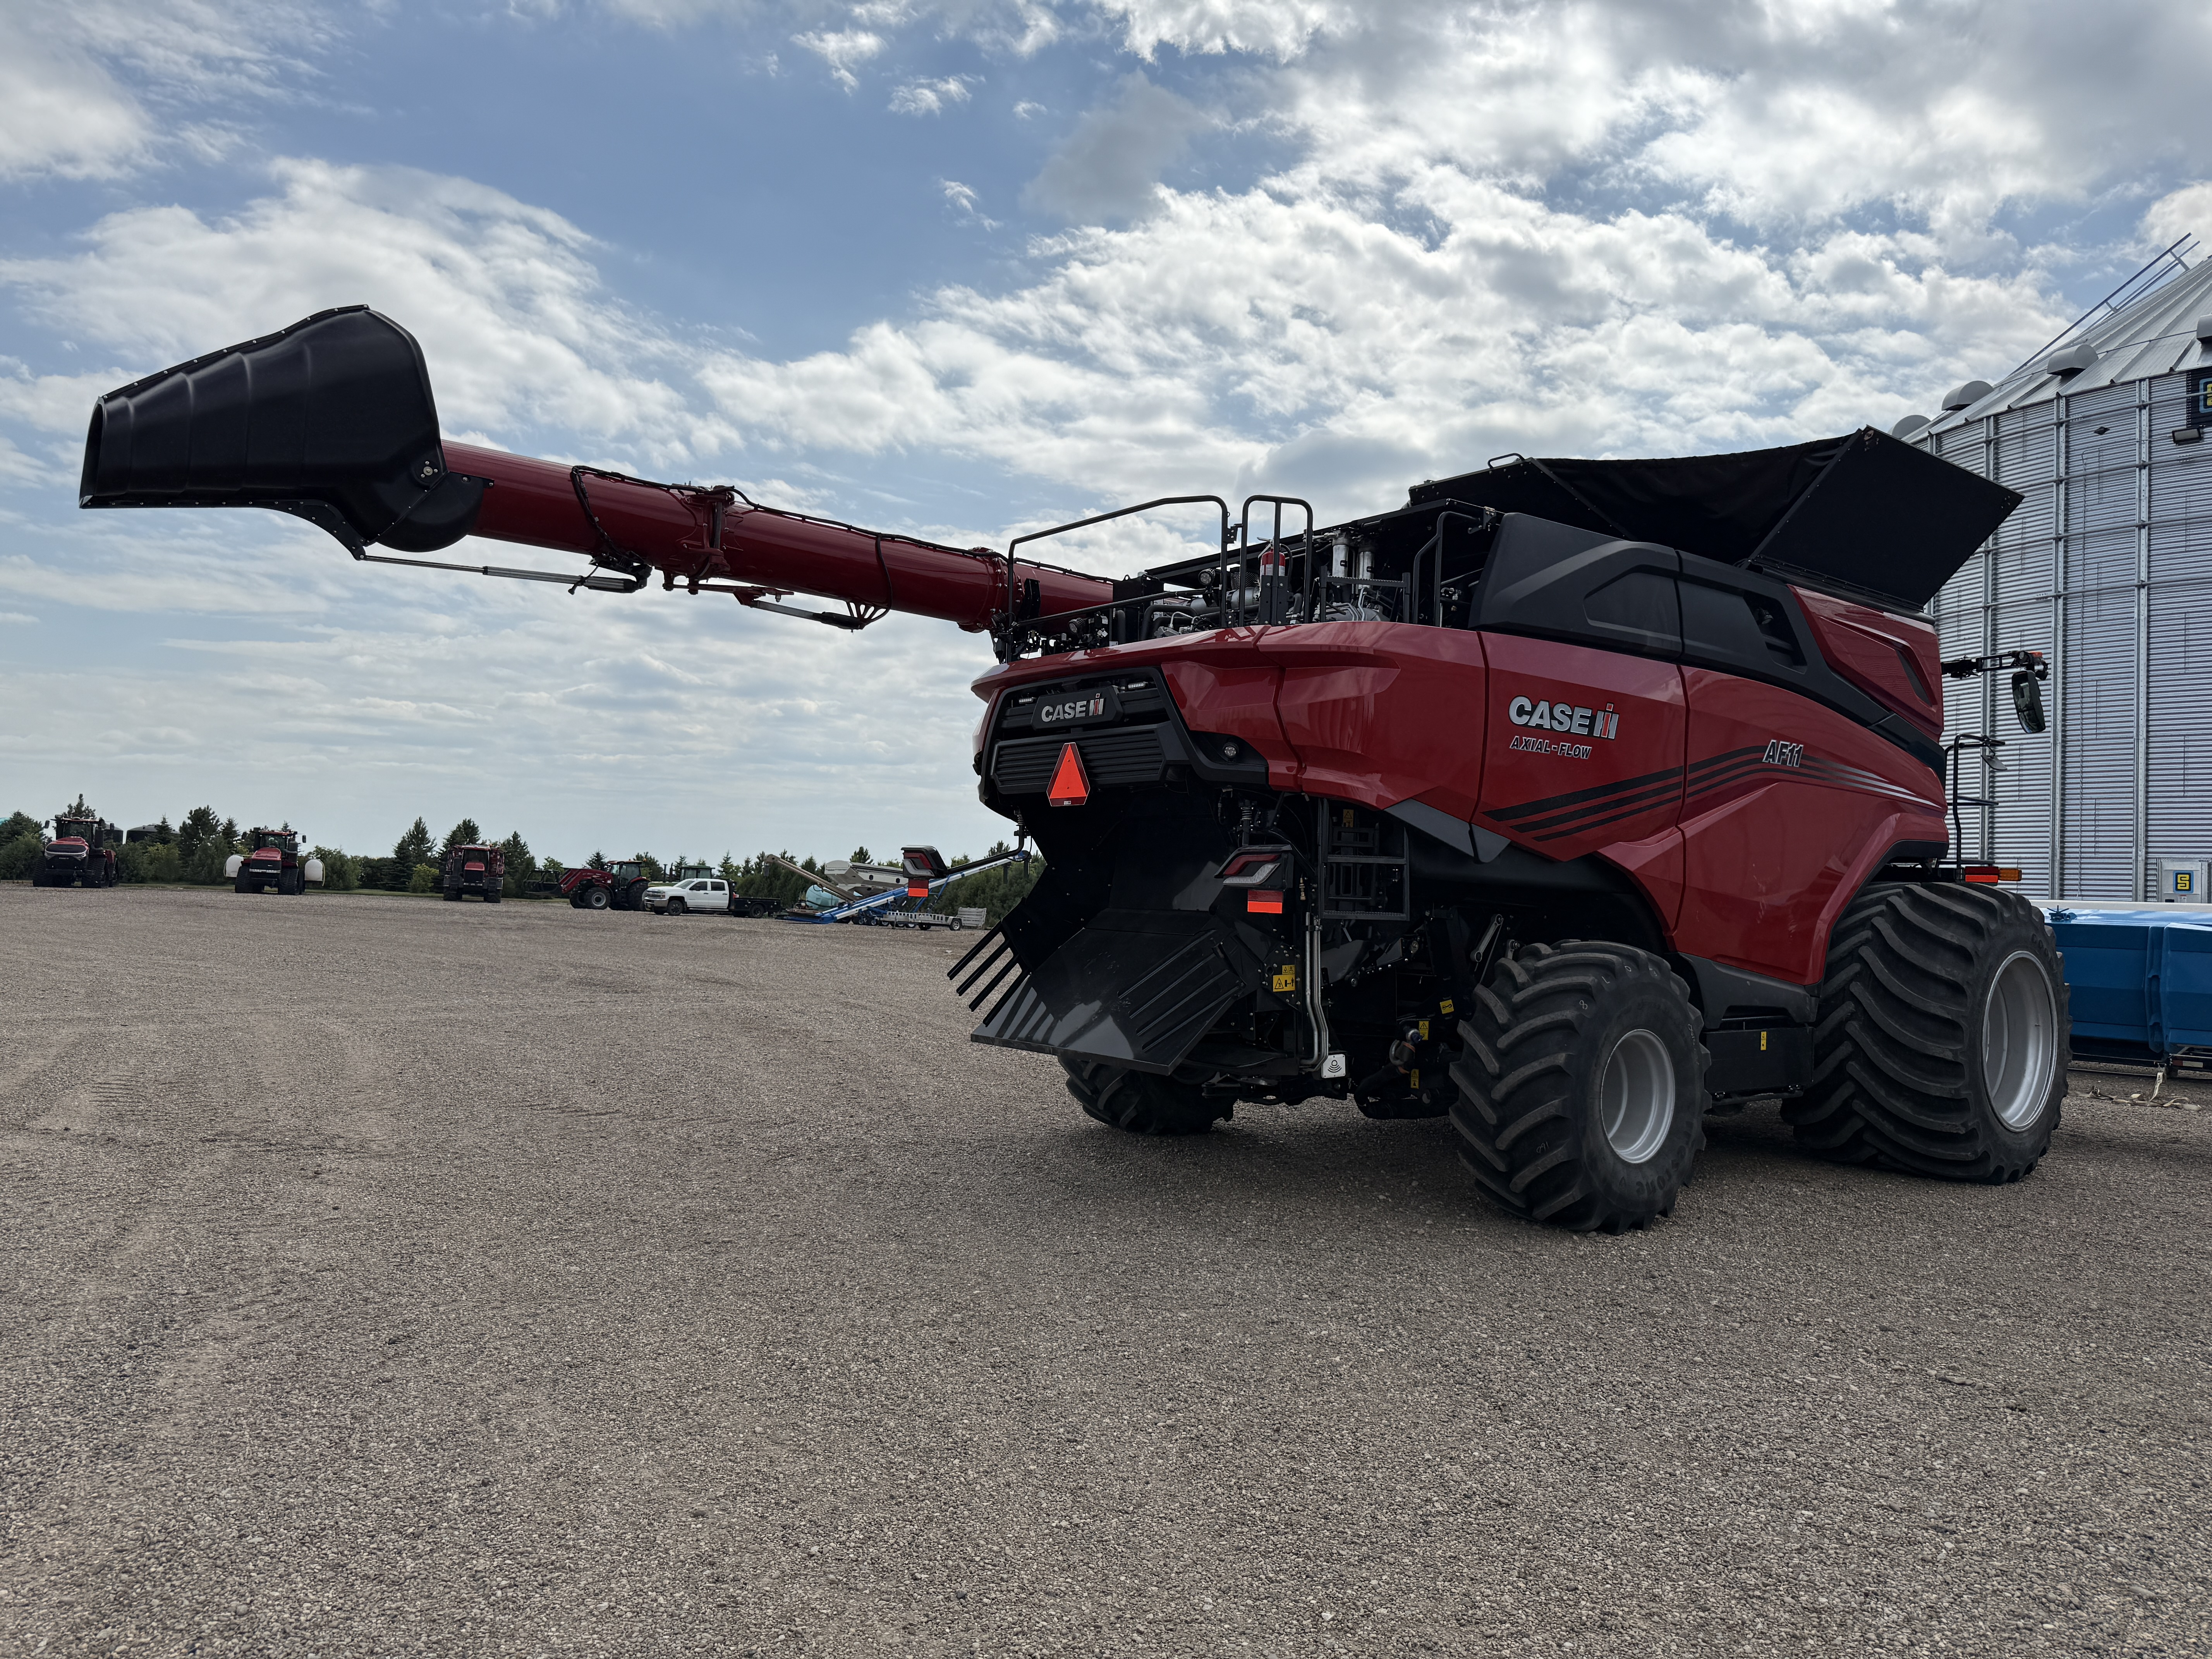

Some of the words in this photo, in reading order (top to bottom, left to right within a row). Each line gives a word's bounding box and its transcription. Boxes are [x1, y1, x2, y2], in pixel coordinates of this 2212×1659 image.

[1041, 700, 1087, 722] CASE
[1509, 696, 1592, 735] CASE
[1762, 739, 1804, 767] AF11
